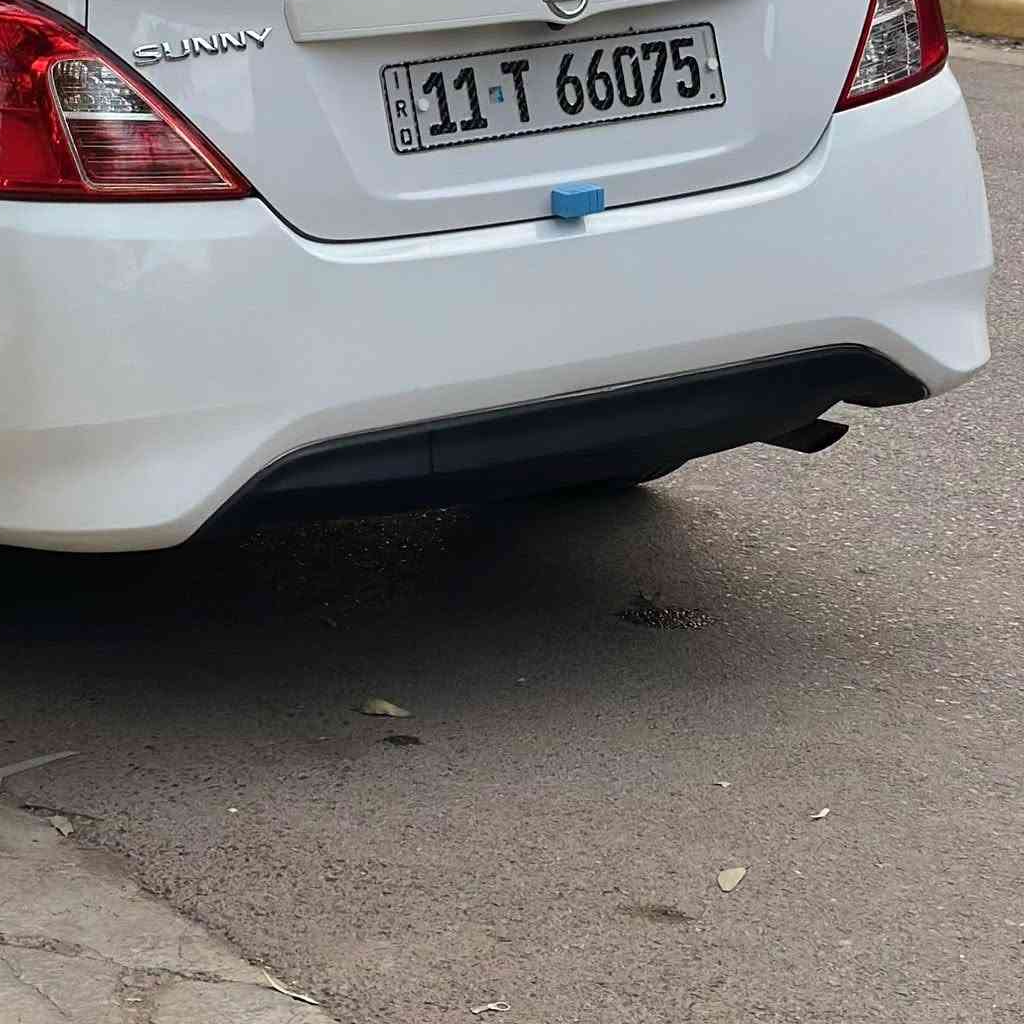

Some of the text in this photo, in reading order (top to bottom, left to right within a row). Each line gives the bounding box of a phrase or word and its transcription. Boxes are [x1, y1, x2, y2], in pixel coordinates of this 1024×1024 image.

[133, 27, 273, 66] SUNNY
[422, 37, 702, 136] 11 T 66075
